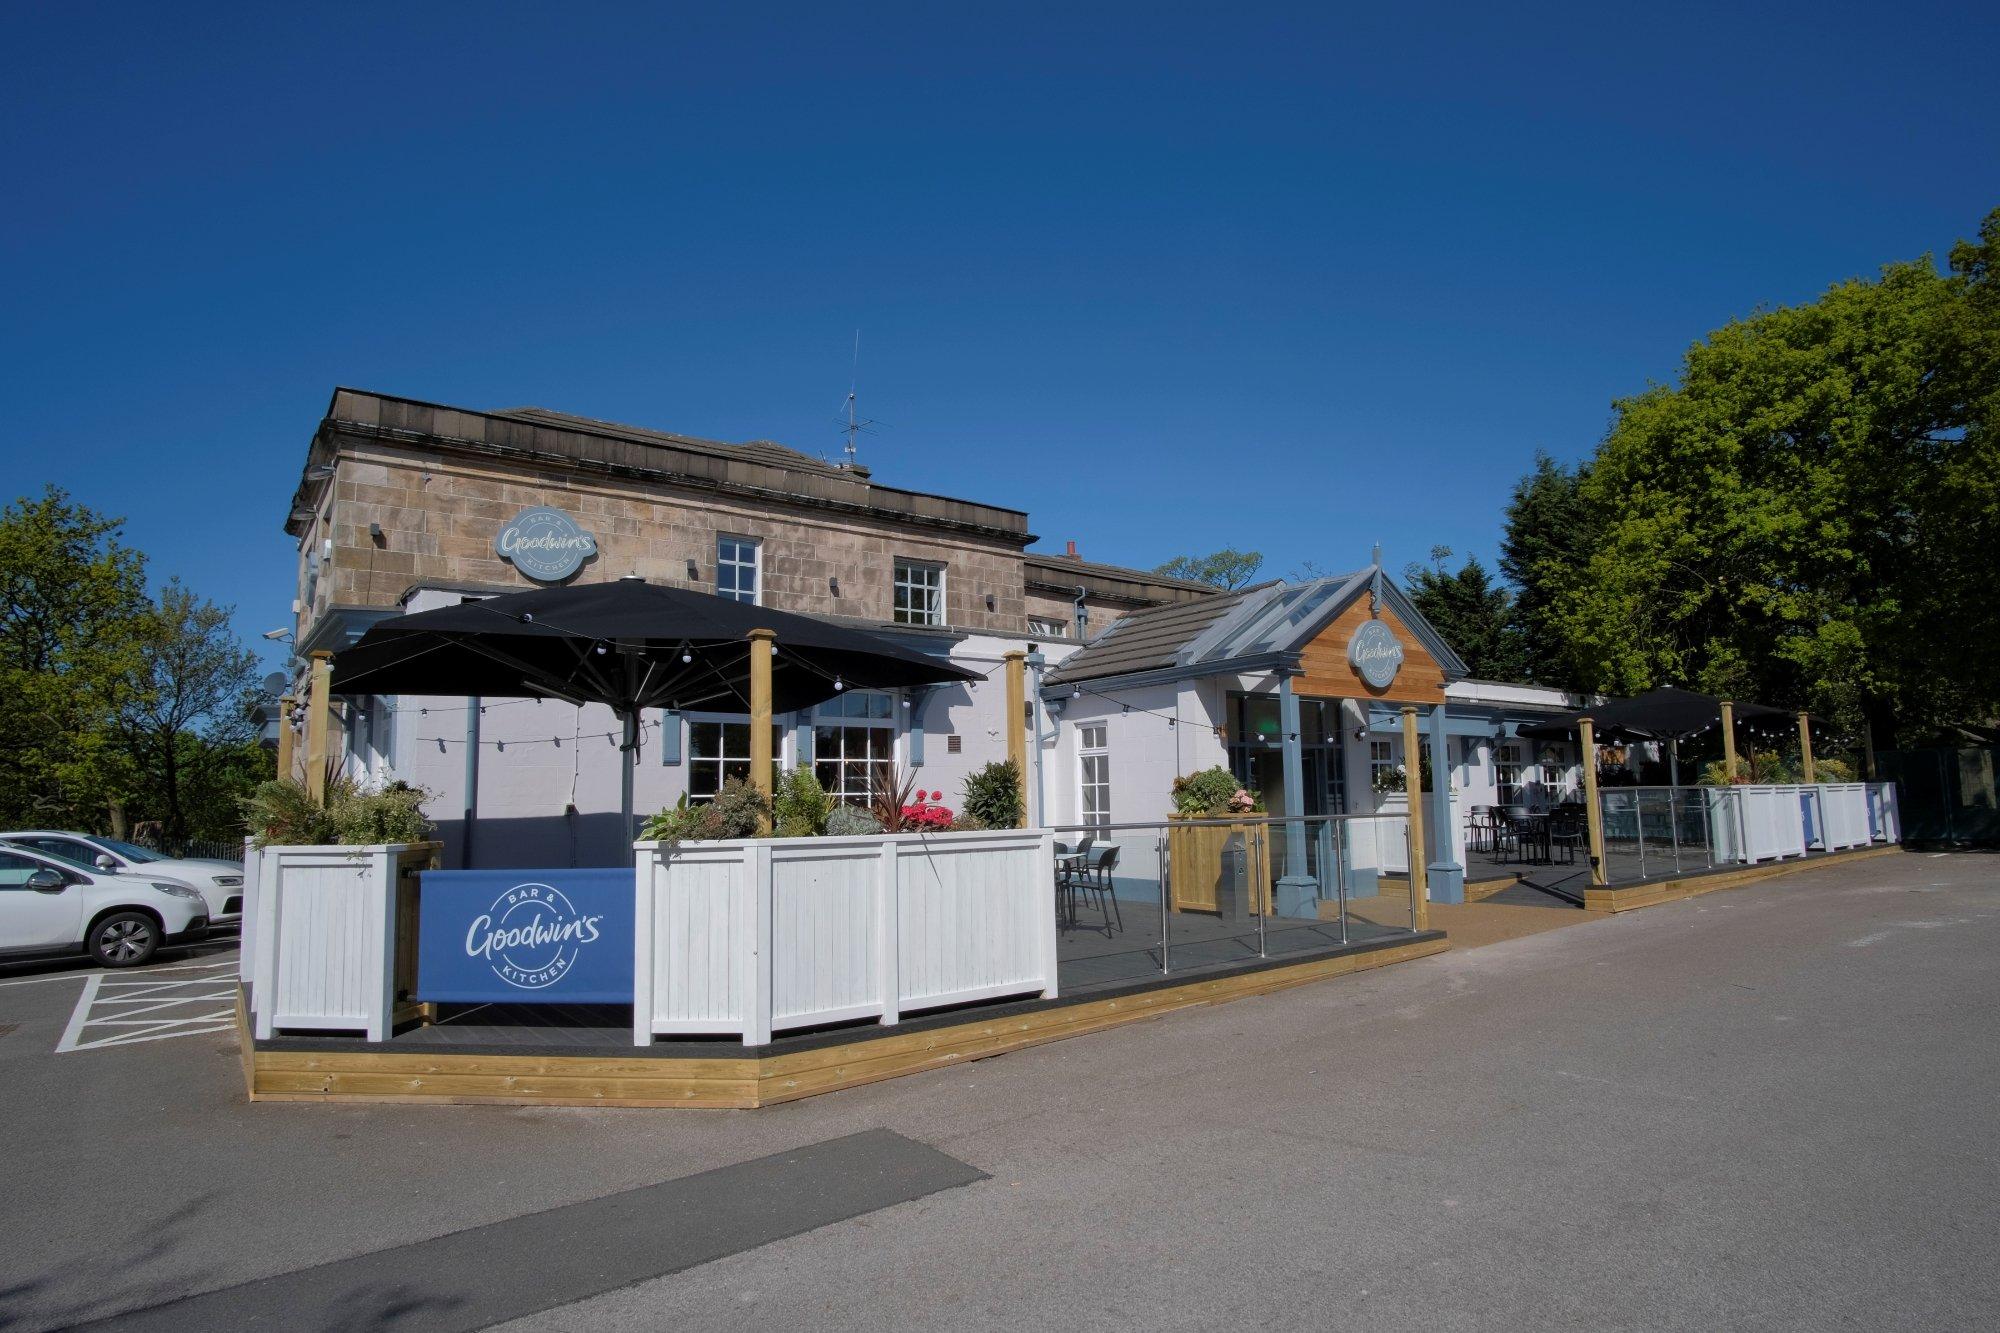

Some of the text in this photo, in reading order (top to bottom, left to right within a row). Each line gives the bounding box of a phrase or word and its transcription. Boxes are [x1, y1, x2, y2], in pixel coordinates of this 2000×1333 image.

[530, 516, 551, 524] BAR
[501, 527, 591, 555] Goodwin's
[527, 558, 570, 571] KITCHEN
[508, 888, 554, 904] BAR &
[465, 913, 600, 961] Goodwin's
[502, 958, 567, 984] KITCHEN
